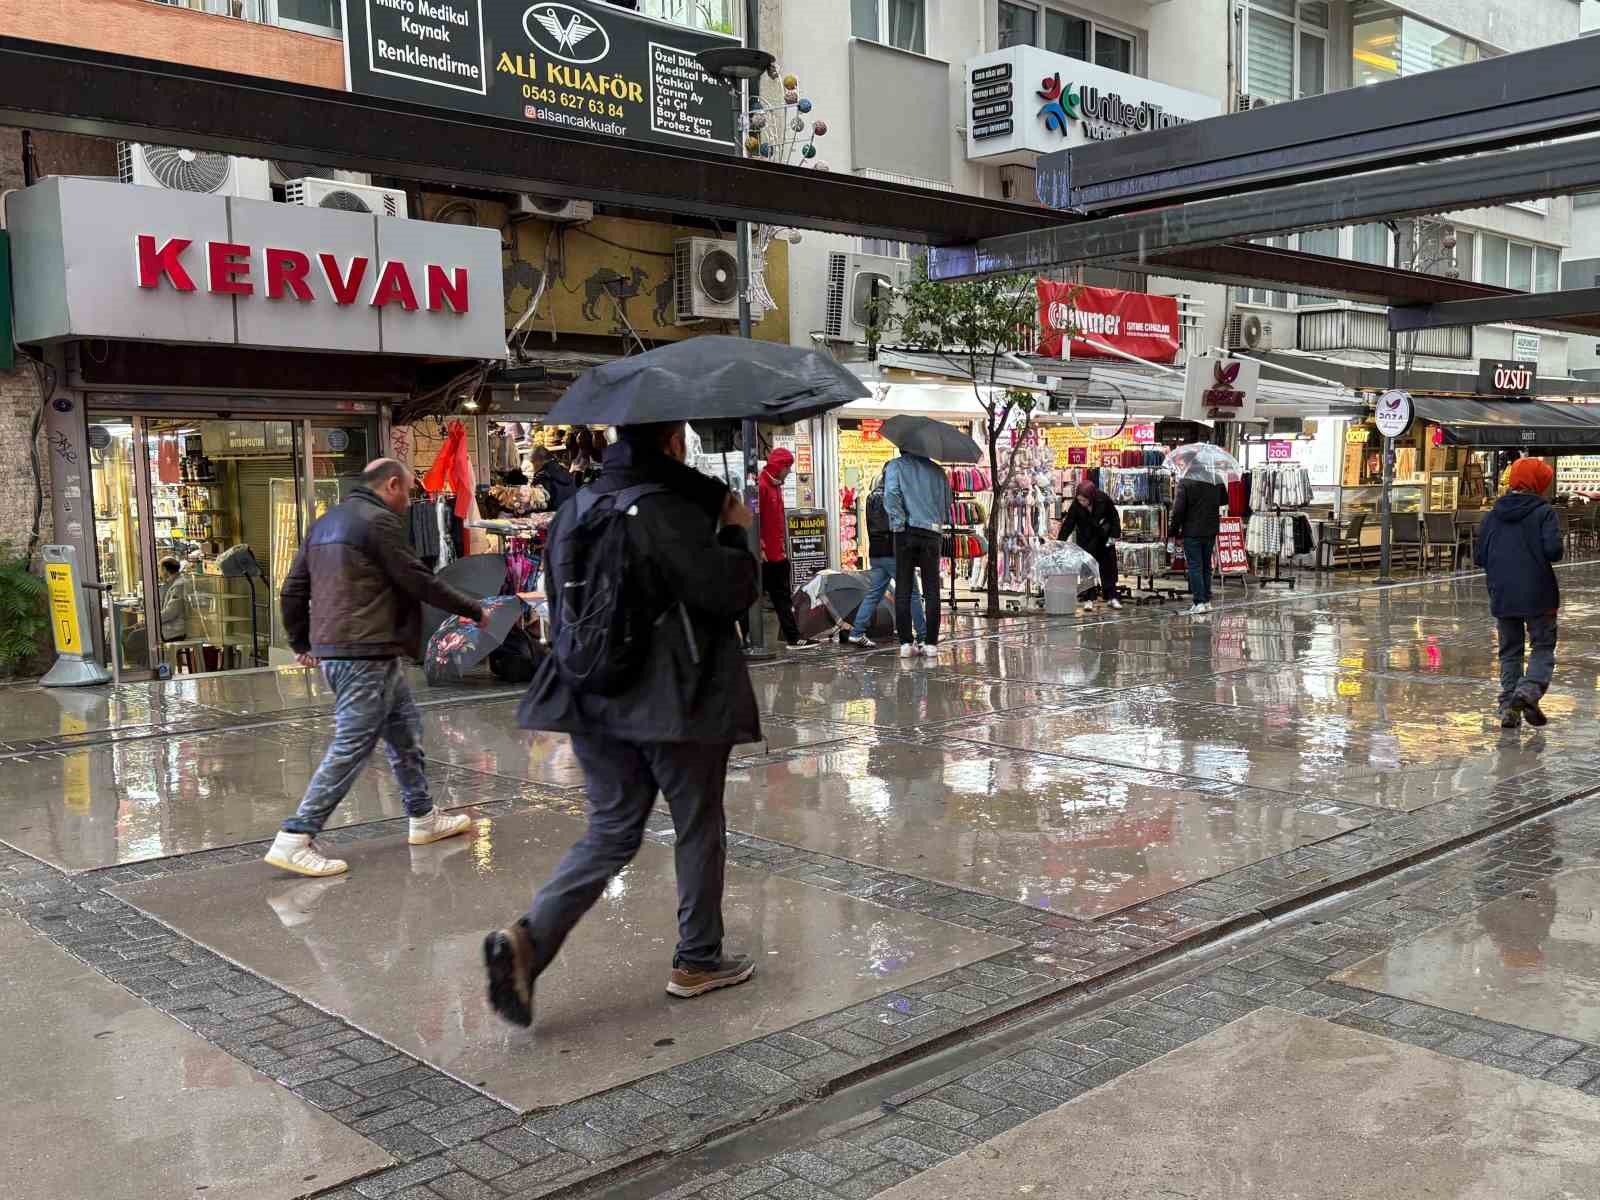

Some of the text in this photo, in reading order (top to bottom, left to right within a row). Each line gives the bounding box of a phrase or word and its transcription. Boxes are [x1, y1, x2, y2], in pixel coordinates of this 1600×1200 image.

[418, 1, 469, 26] Medikal
[401, 16, 450, 42] Kaynak
[378, 39, 479, 78] Renklendirme
[655, 48, 676, 64] Özel
[496, 51, 644, 103] ALİ KUAFÖR
[656, 63, 698, 80] Medikal
[522, 84, 624, 118] 0543 627 63 84
[656, 84, 704, 104] Yarım Ay
[656, 107, 712, 126] Bay Bayan
[656, 117, 691, 132] Protez
[135, 233, 470, 313] KERVAN
[1494, 363, 1533, 390] ÖZSÜT
[1135, 428, 1154, 439] 450
[1103, 455, 1118, 466] 50
[1270, 449, 1288, 457] 200
